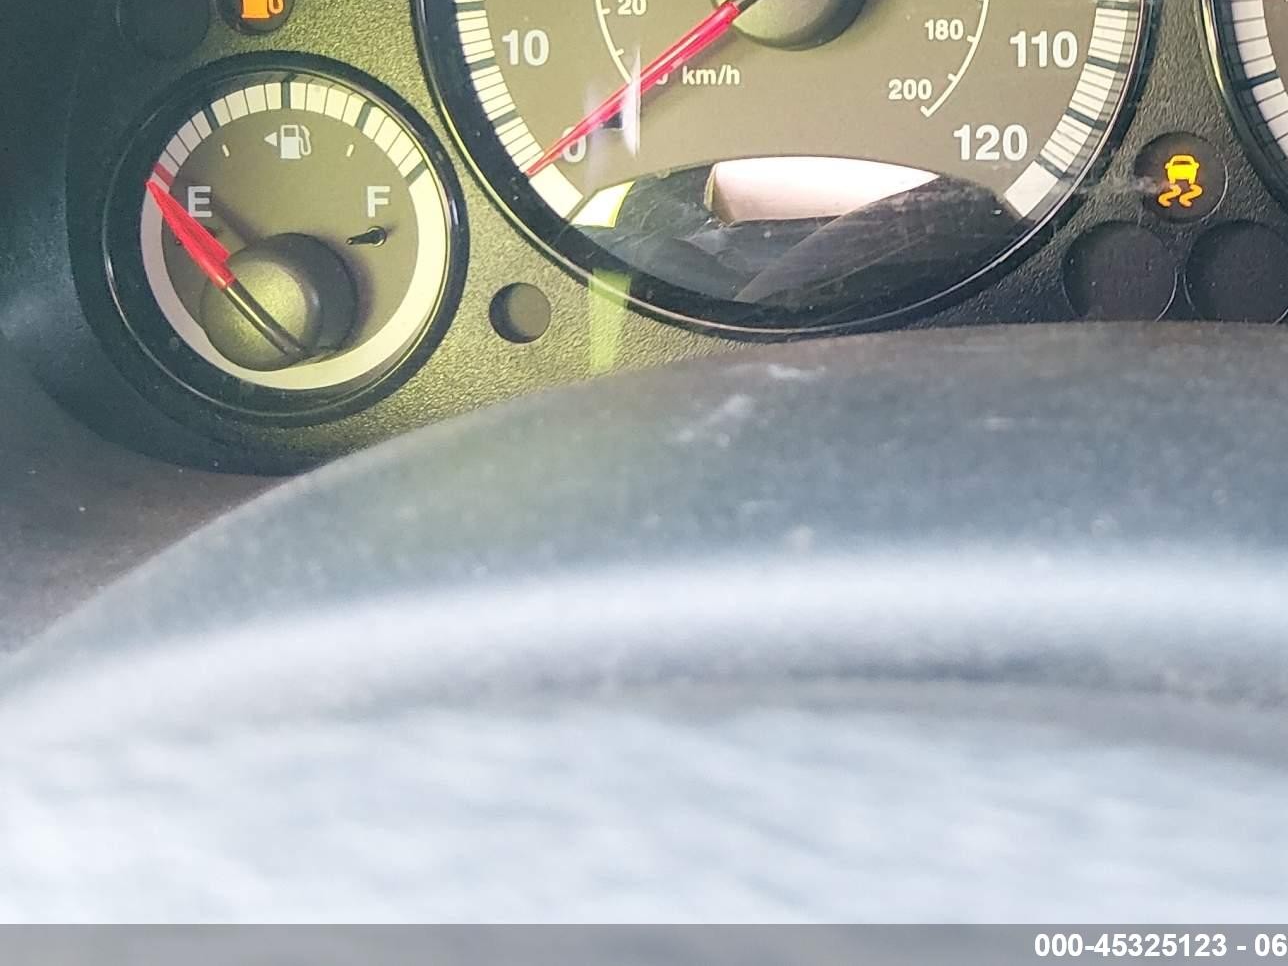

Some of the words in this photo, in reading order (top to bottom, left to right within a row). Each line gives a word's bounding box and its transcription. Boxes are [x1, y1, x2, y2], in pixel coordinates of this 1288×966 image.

[924, 19, 964, 41] 180
[502, 29, 549, 66] 10
[1009, 30, 1078, 68] 110
[682, 64, 740, 86] km/h
[887, 79, 933, 102] 200
[953, 124, 1028, 161] 120
[187, 185, 213, 219] E
[366, 185, 391, 218] F
